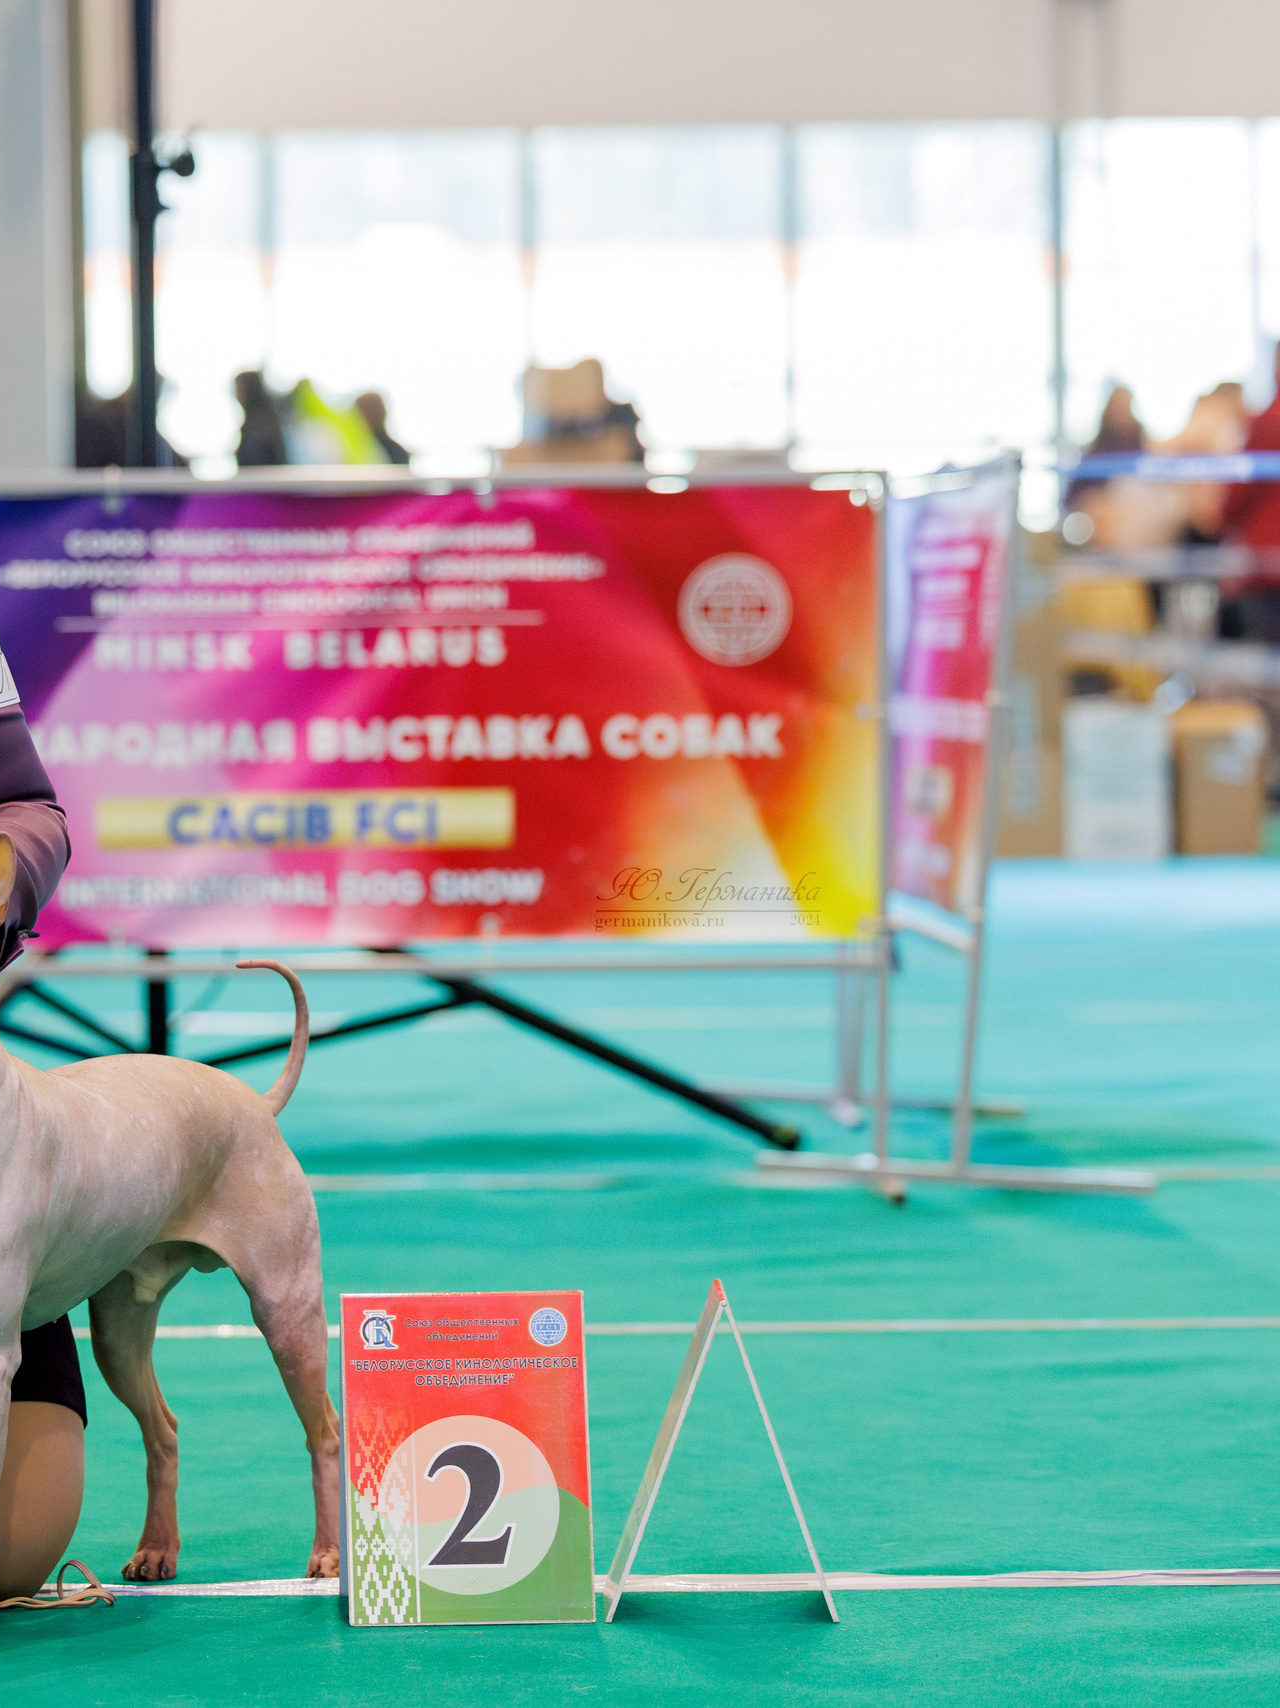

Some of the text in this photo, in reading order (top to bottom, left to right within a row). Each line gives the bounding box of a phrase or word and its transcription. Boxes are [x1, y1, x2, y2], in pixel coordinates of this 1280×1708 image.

[94, 628, 507, 671] MINSK BELARUS
[306, 715, 591, 764] ВЫСТАВКА
[601, 713, 783, 759] СОБАК
[166, 802, 439, 846] CACIB FCI
[337, 869, 425, 907] DOG
[431, 867, 545, 905] SHOW
[404, 1316, 519, 1329] Союз общественных
[425, 1330, 498, 1342] объединений
[350, 1357, 578, 1372] "БЕЛОРУССКОЕ КИНОЛОГИЧЕСКОЕ
[414, 1374, 515, 1388] ОБЪЕДИНЕНИЕ"
[423, 1441, 517, 1569] 2
